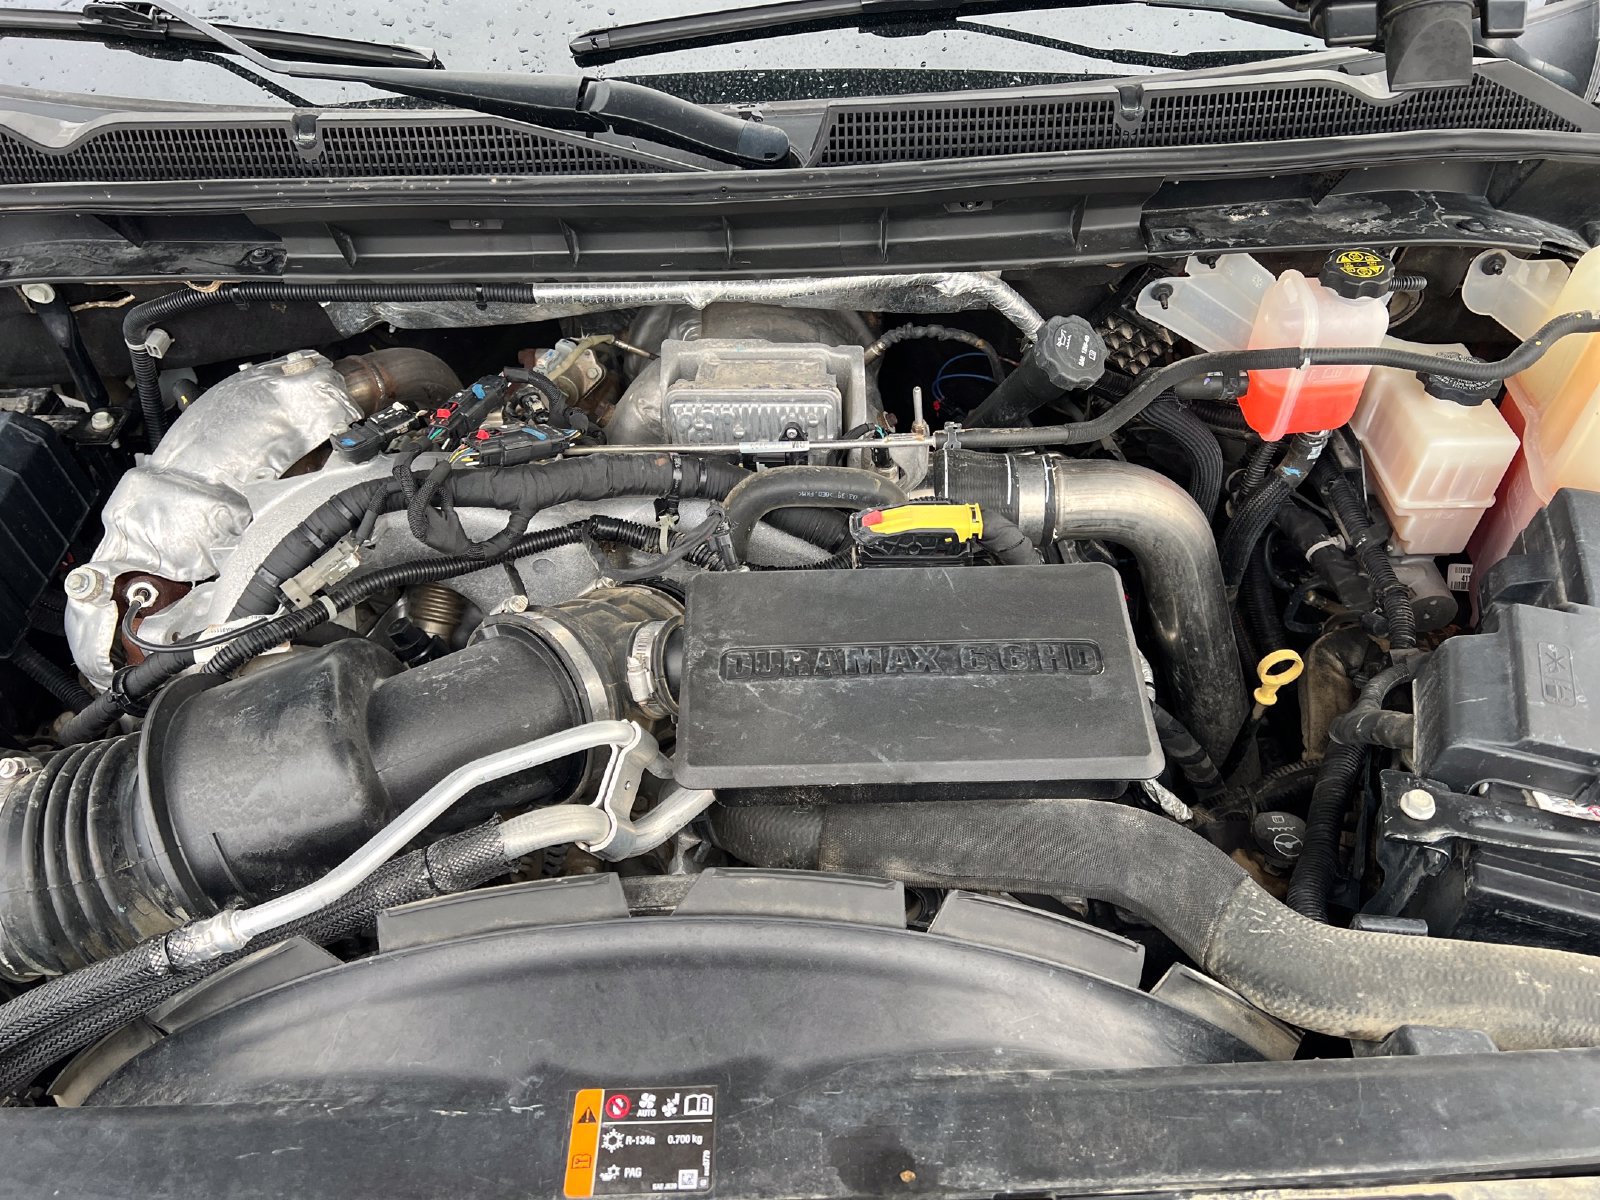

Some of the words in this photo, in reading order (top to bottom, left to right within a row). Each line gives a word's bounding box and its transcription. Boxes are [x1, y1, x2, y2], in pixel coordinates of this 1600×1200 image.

[726, 646, 942, 679] DURAMAX
[636, 1109, 657, 1117] AUTO
[625, 1136, 656, 1145] R-134a
[667, 1135, 691, 1144] 0.700
[691, 1134, 703, 1145] kg
[623, 1167, 642, 1178] PAG
